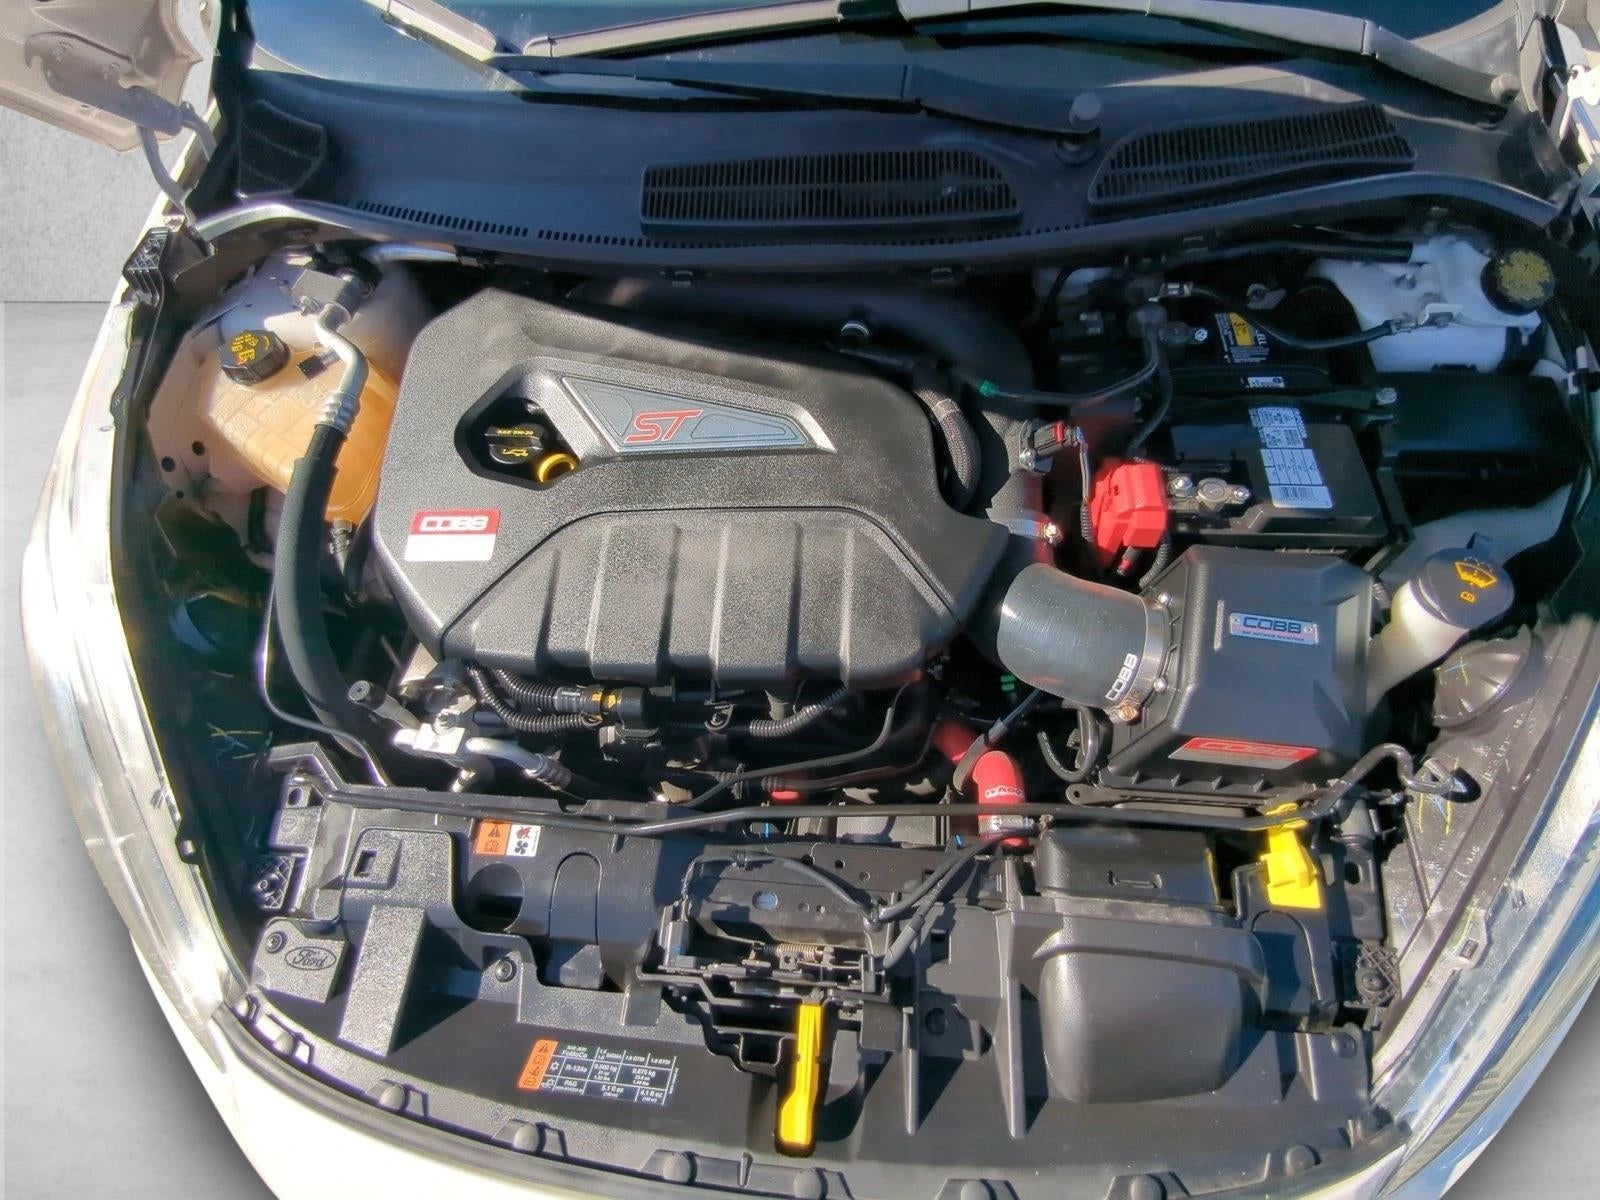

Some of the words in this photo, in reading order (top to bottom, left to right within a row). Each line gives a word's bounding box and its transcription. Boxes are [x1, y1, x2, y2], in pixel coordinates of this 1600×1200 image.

[623, 409, 704, 443] ST
[419, 515, 490, 532] COBB
[1243, 616, 1302, 634] COBB
[1105, 653, 1138, 701] COBB
[1199, 741, 1299, 758] COBB
[292, 948, 329, 968] Ford
[562, 1050, 588, 1059] FoMoCo
[565, 1064, 588, 1073] R-134a
